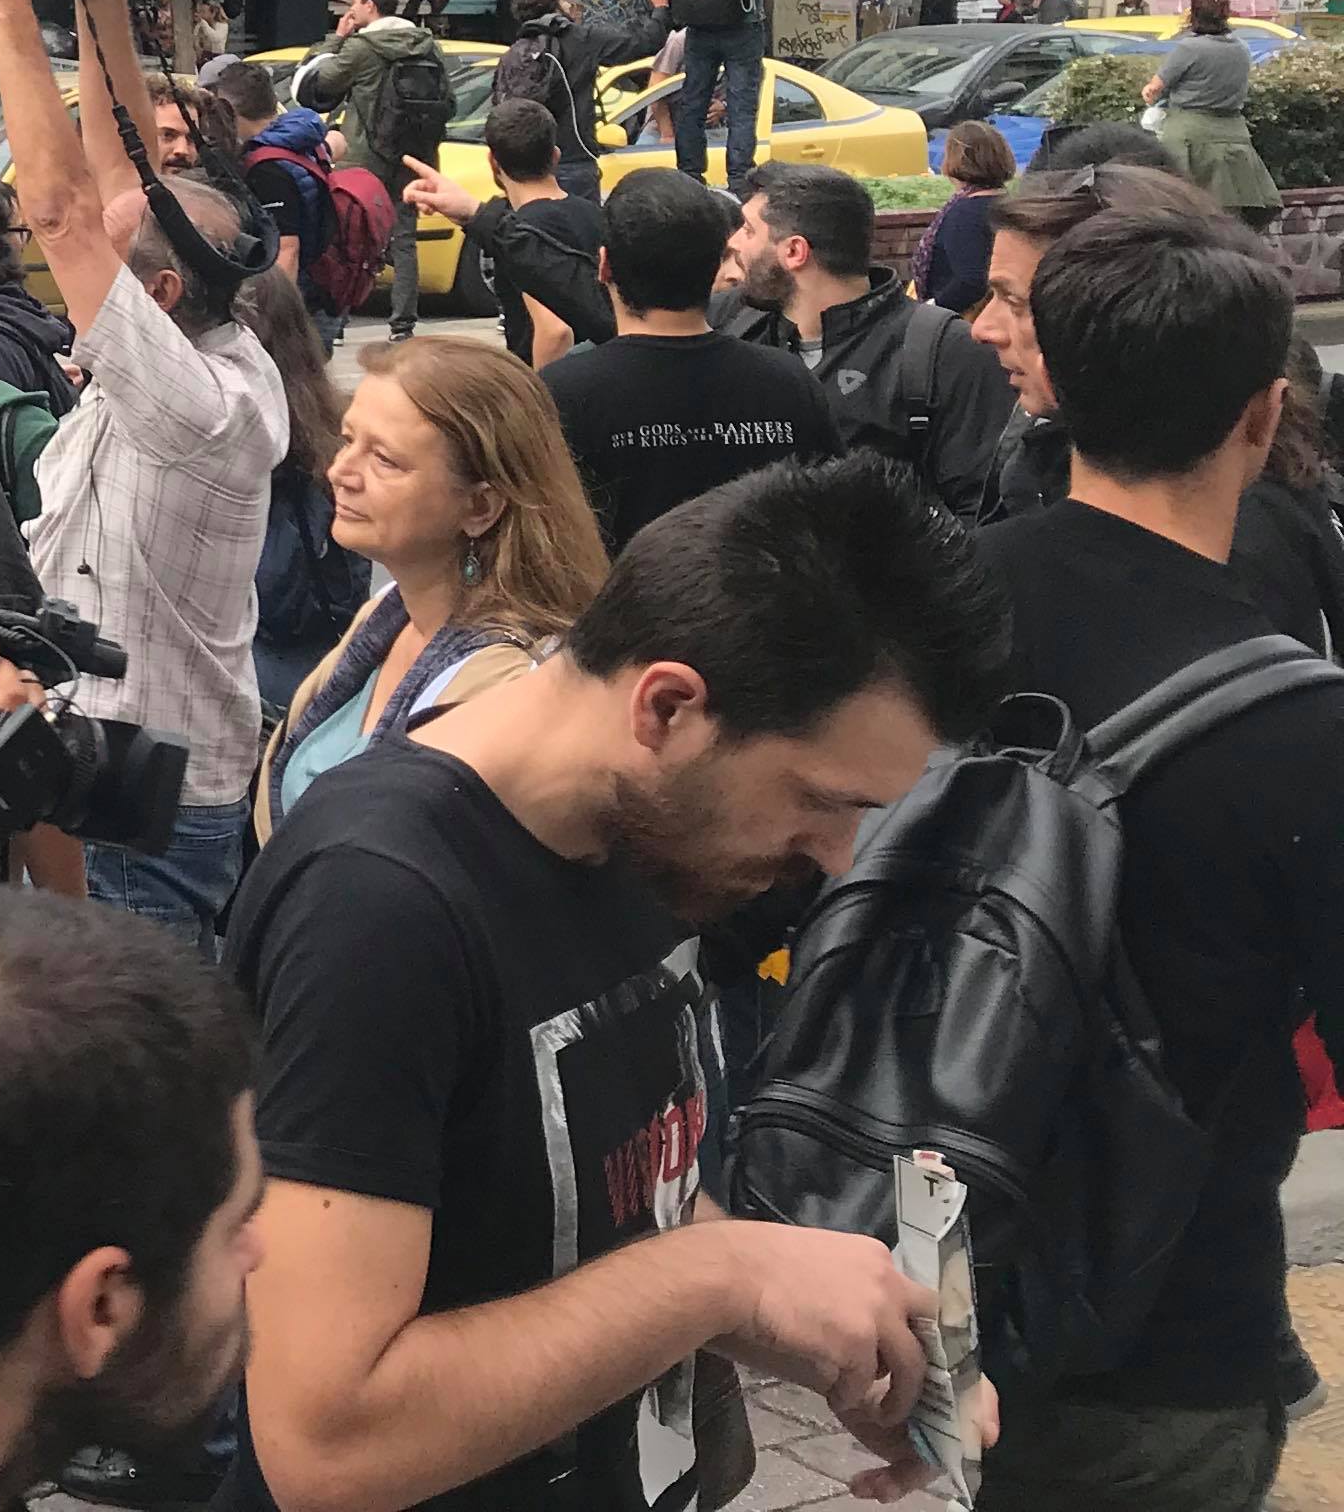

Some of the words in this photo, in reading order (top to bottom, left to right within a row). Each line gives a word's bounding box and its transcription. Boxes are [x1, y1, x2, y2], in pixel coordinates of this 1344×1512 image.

[639, 423, 682, 437] GODS
[714, 421, 793, 435] BANKERS
[640, 434, 688, 448] KINGS
[723, 432, 794, 445] THIEVES
